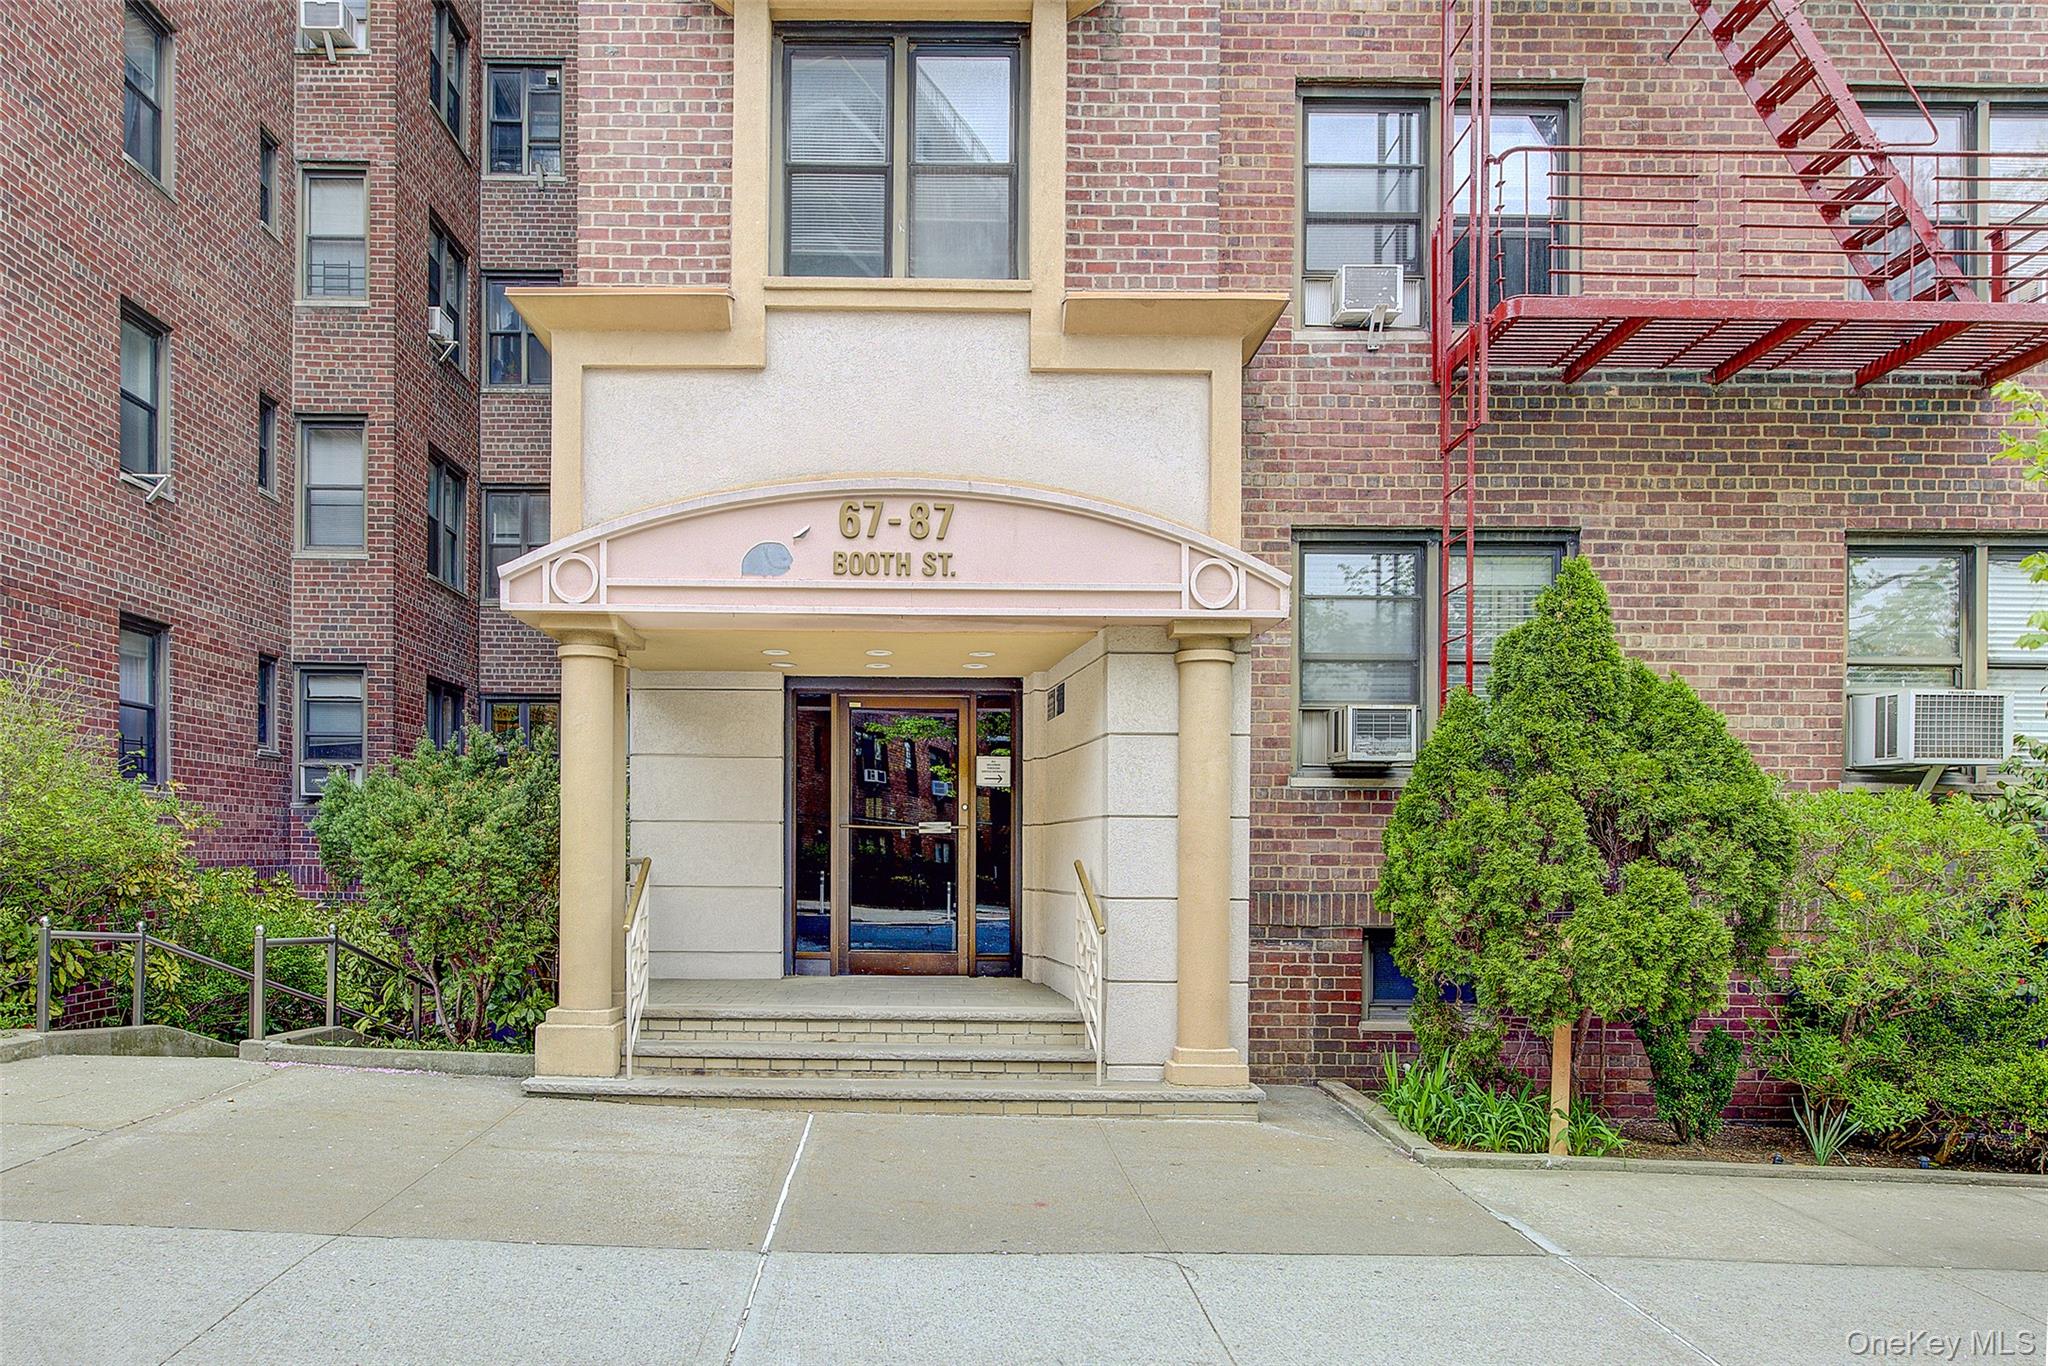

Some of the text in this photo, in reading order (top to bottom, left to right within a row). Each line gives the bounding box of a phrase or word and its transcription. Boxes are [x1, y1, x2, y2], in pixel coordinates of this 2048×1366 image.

[839, 500, 954, 540] 67-87
[833, 552, 956, 577] BOOTH ST.
